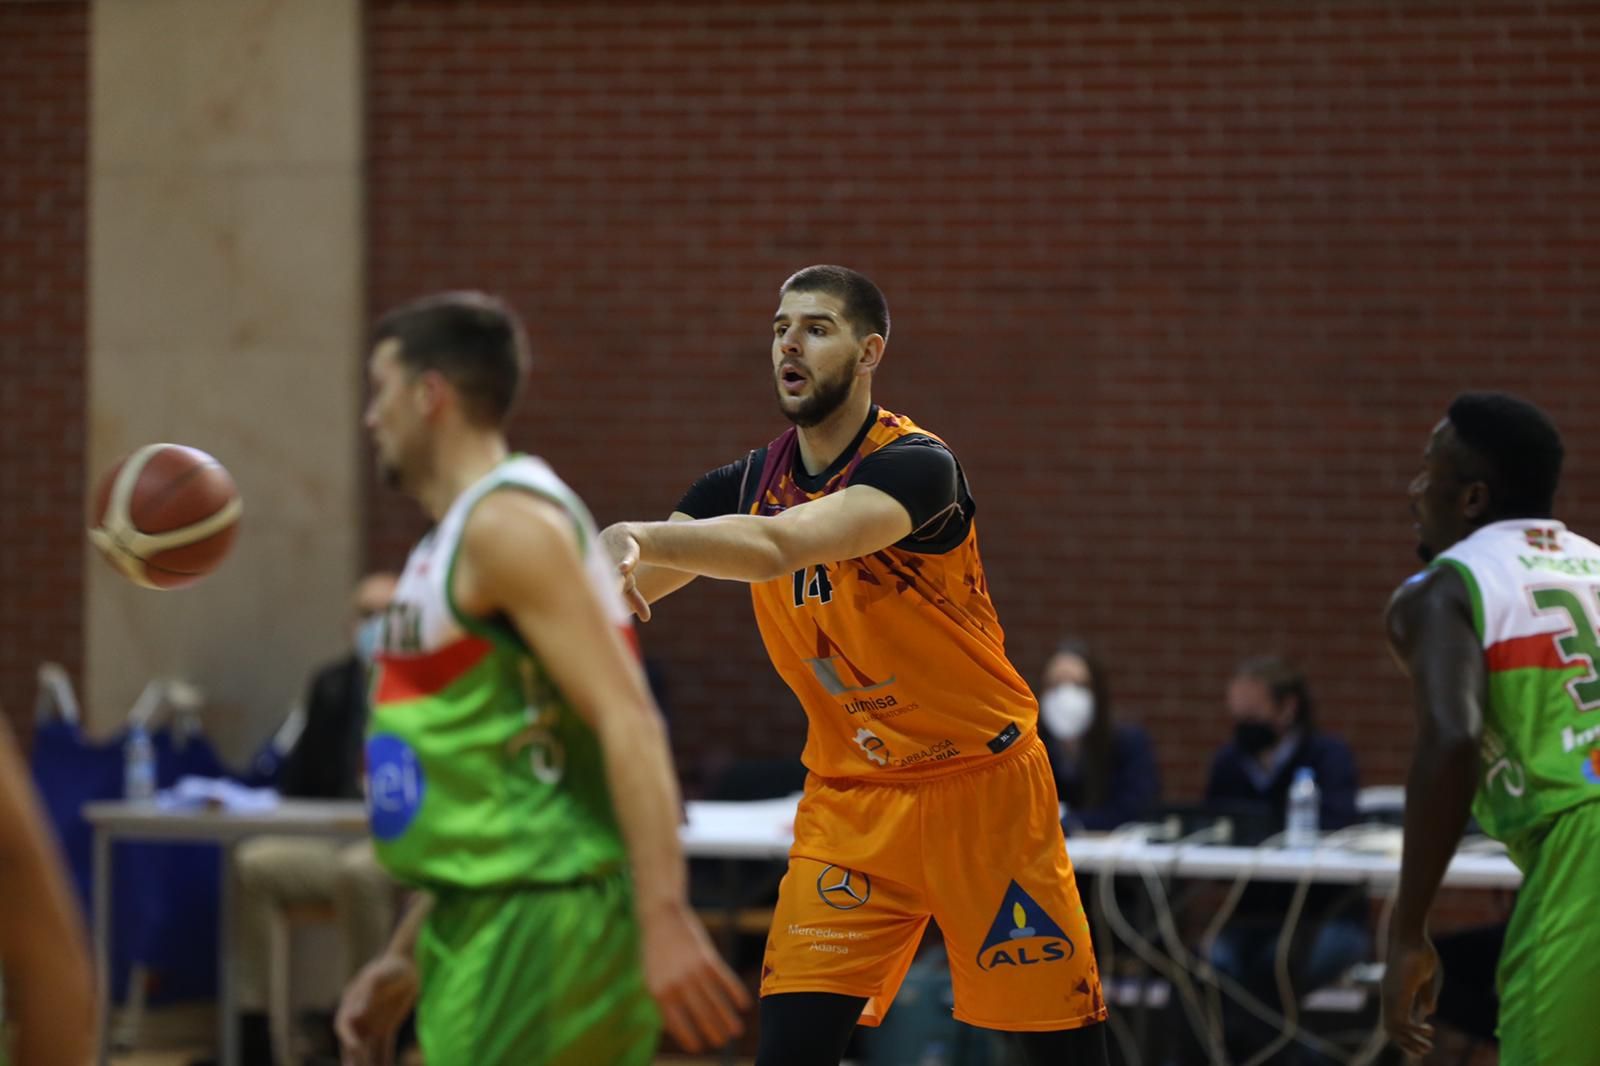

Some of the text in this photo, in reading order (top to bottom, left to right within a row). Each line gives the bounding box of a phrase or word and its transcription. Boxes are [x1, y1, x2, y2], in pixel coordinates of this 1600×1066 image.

[792, 562, 833, 608] 14
[1525, 584, 1600, 712] 3
[894, 739, 954, 767] CARBAJOSA
[988, 942, 1065, 969] ALS
